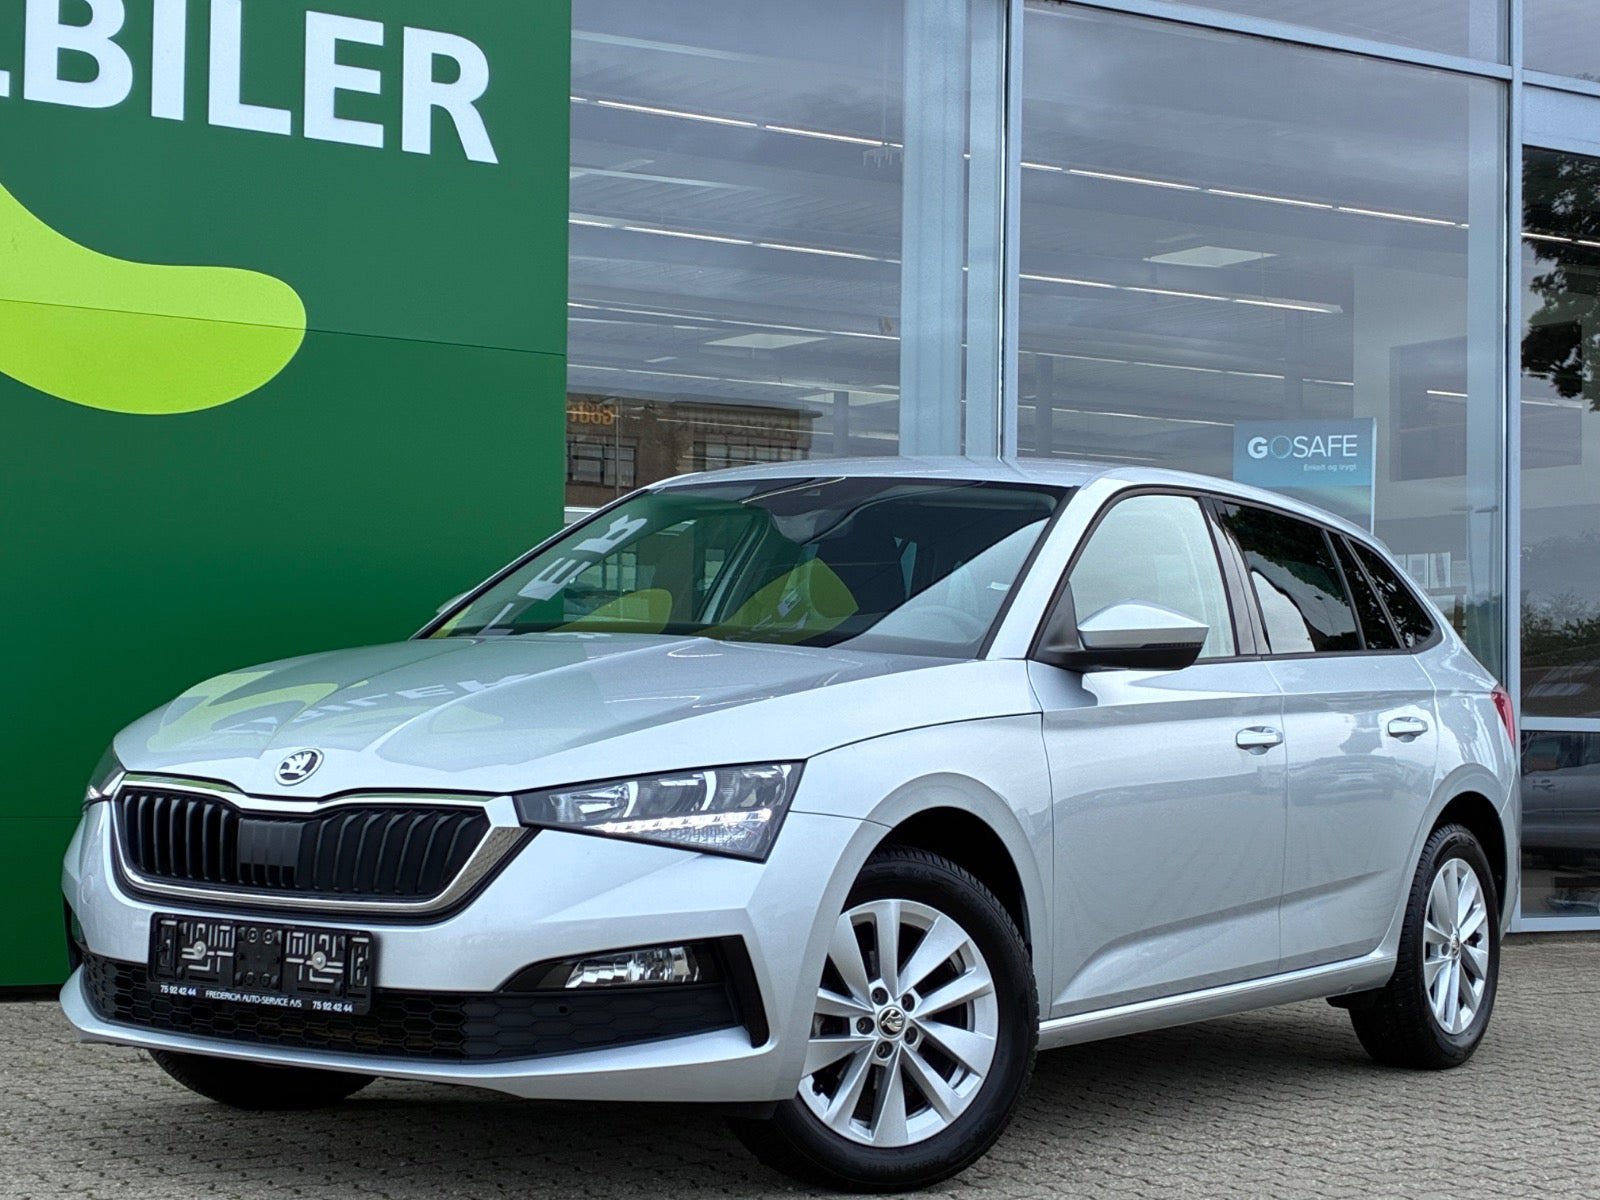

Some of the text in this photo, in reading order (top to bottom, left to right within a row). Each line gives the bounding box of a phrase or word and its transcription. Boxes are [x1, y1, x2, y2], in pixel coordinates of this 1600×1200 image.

[0, 0, 498, 164] BILER
[1247, 434, 1358, 459] GOSAFE
[160, 985, 169, 994] 75
[169, 986, 178, 995] 92
[178, 987, 188, 996] 42
[187, 988, 197, 997] 44
[205, 990, 241, 1001] FREDERICIA
[242, 994, 288, 1006] AUTO-SERVICE
[289, 999, 302, 1008] A/S
[312, 1000, 323, 1010] 75
[332, 1003, 343, 1012] 42
[343, 1003, 353, 1013] 44
